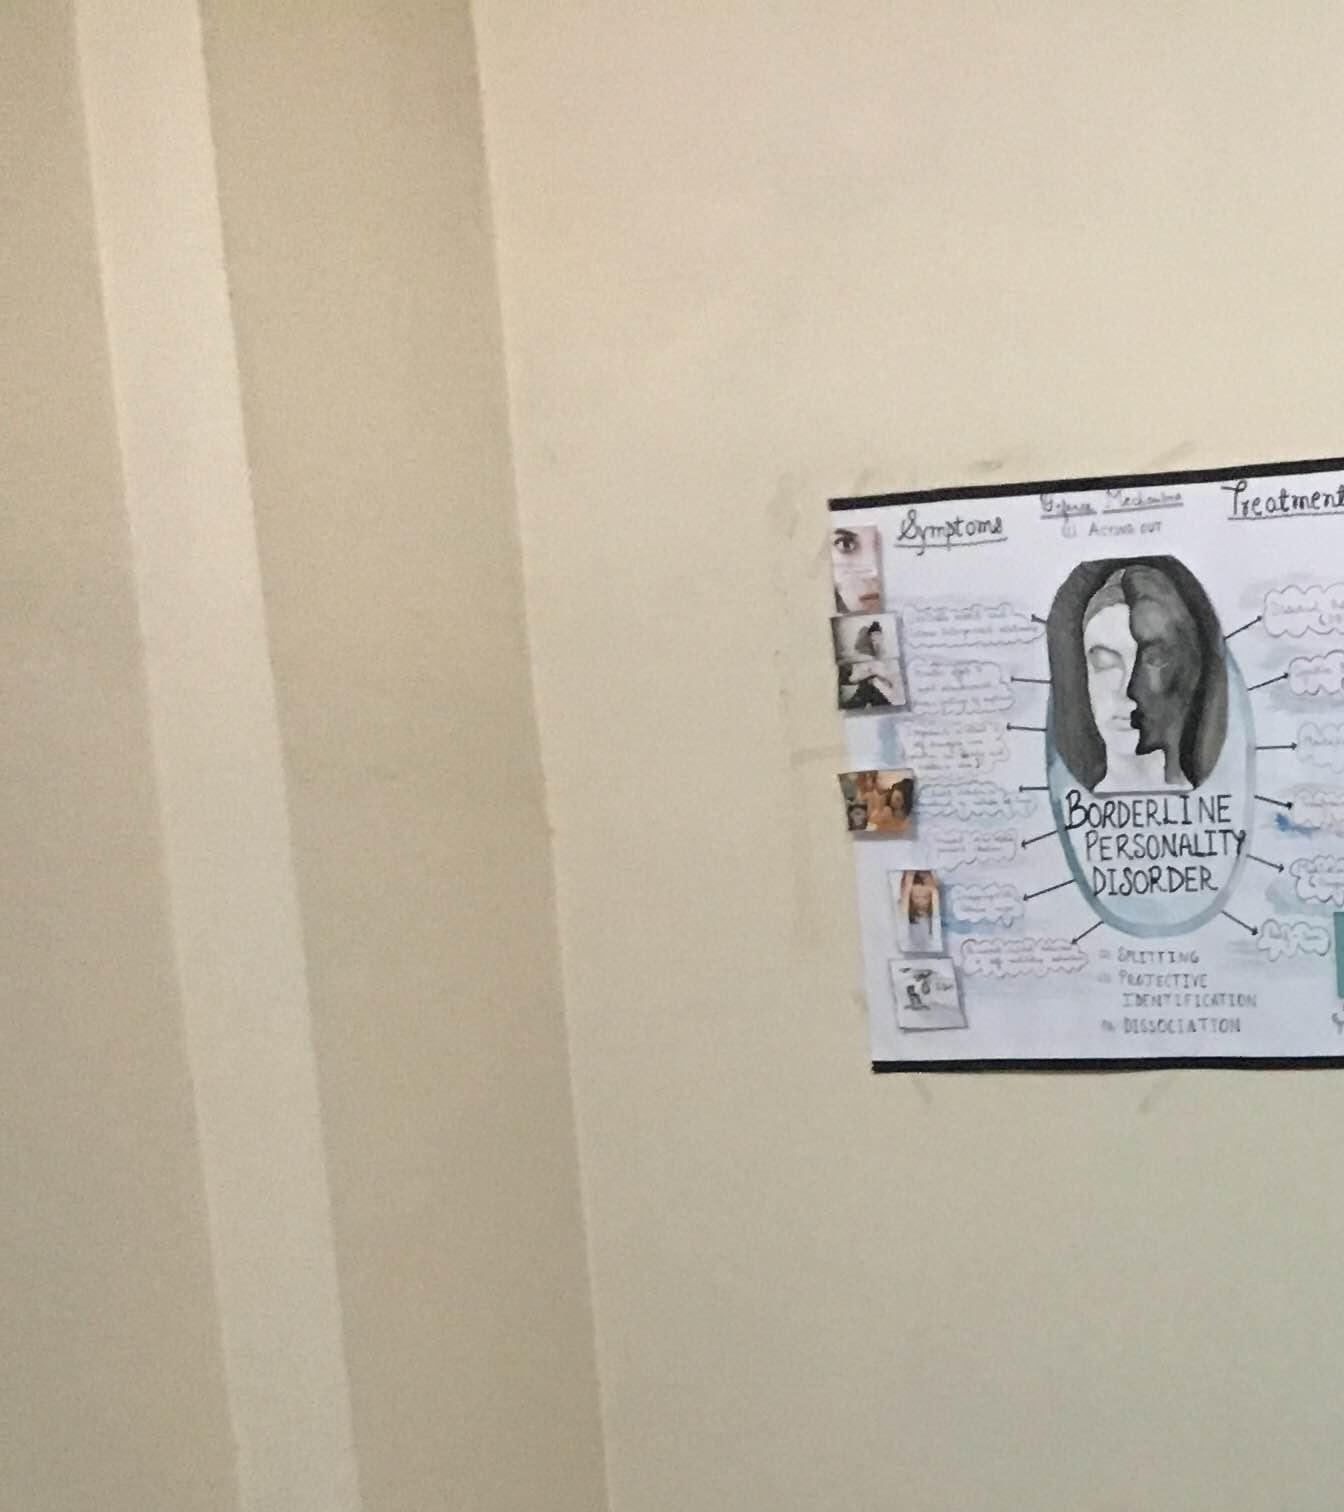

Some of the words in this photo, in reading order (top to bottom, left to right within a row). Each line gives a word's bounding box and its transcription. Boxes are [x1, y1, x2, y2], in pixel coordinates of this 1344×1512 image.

[899, 509, 1004, 555] Symptoms
[1065, 790, 1232, 830] BORDERLINE
[1085, 829, 1246, 861] PERSONALITY
[1093, 866, 1218, 896] DISORDER
[1118, 946, 1199, 963] SPLITTING
[1122, 993, 1257, 1008] IDENTIFICATION
[1124, 1018, 1240, 1034] DISSOCIATION
